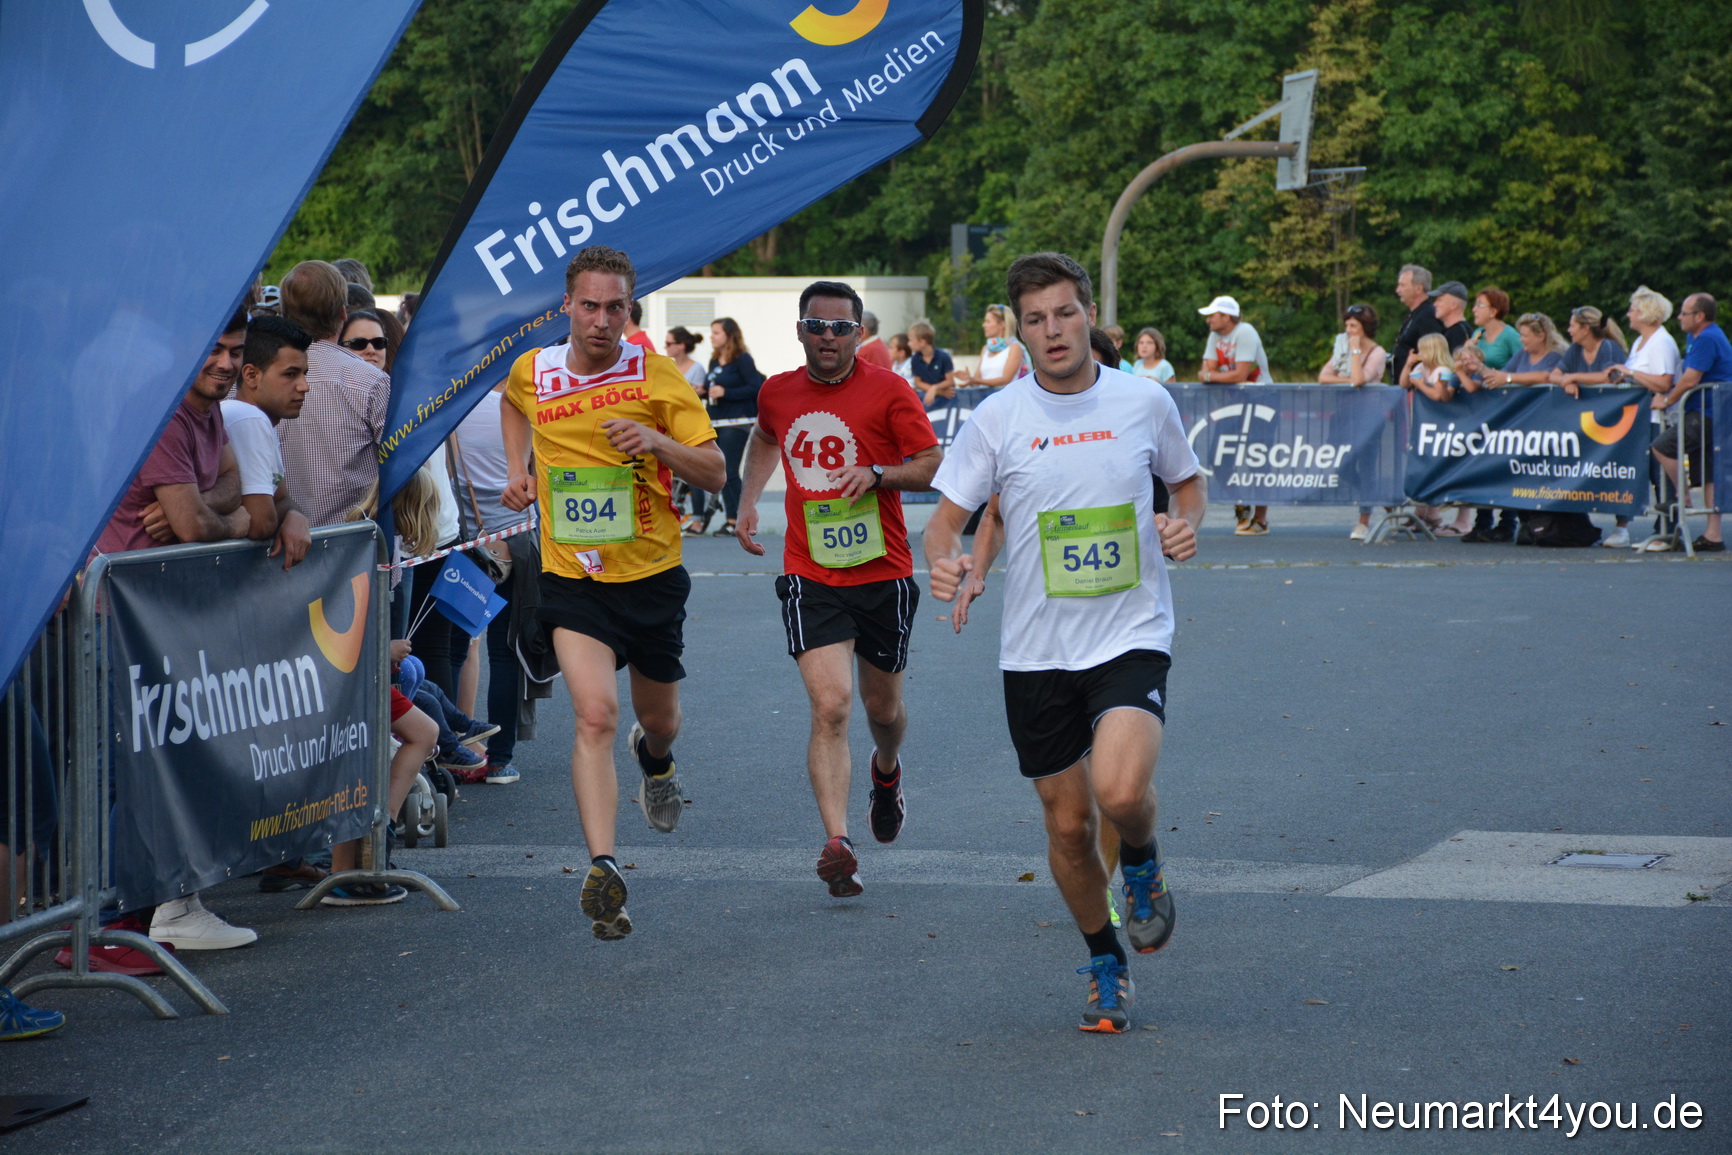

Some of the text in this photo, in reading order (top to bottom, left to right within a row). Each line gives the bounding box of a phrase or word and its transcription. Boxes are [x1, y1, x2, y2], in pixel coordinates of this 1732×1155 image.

[700, 30, 946, 196] Druck und Medien
[474, 57, 822, 296] Frischmann
[536, 387, 649, 426] MAX BÖGL
[1052, 430, 1118, 446] KLEBL
[1213, 434, 1352, 468] Fischer
[1417, 422, 1580, 458] Frischmann
[1226, 472, 1339, 489] AUTOMOBILE
[1509, 459, 1636, 480] Druck und Medien
[565, 497, 617, 523] 894
[1512, 486, 1634, 504] www.frischmann-net.de
[823, 522, 868, 549] 509
[1063, 541, 1121, 572] 543
[1094, 576, 1113, 584] Braun
[128, 649, 325, 753] Frischmann
[249, 734, 296, 781] Druck
[298, 725, 326, 769] und
